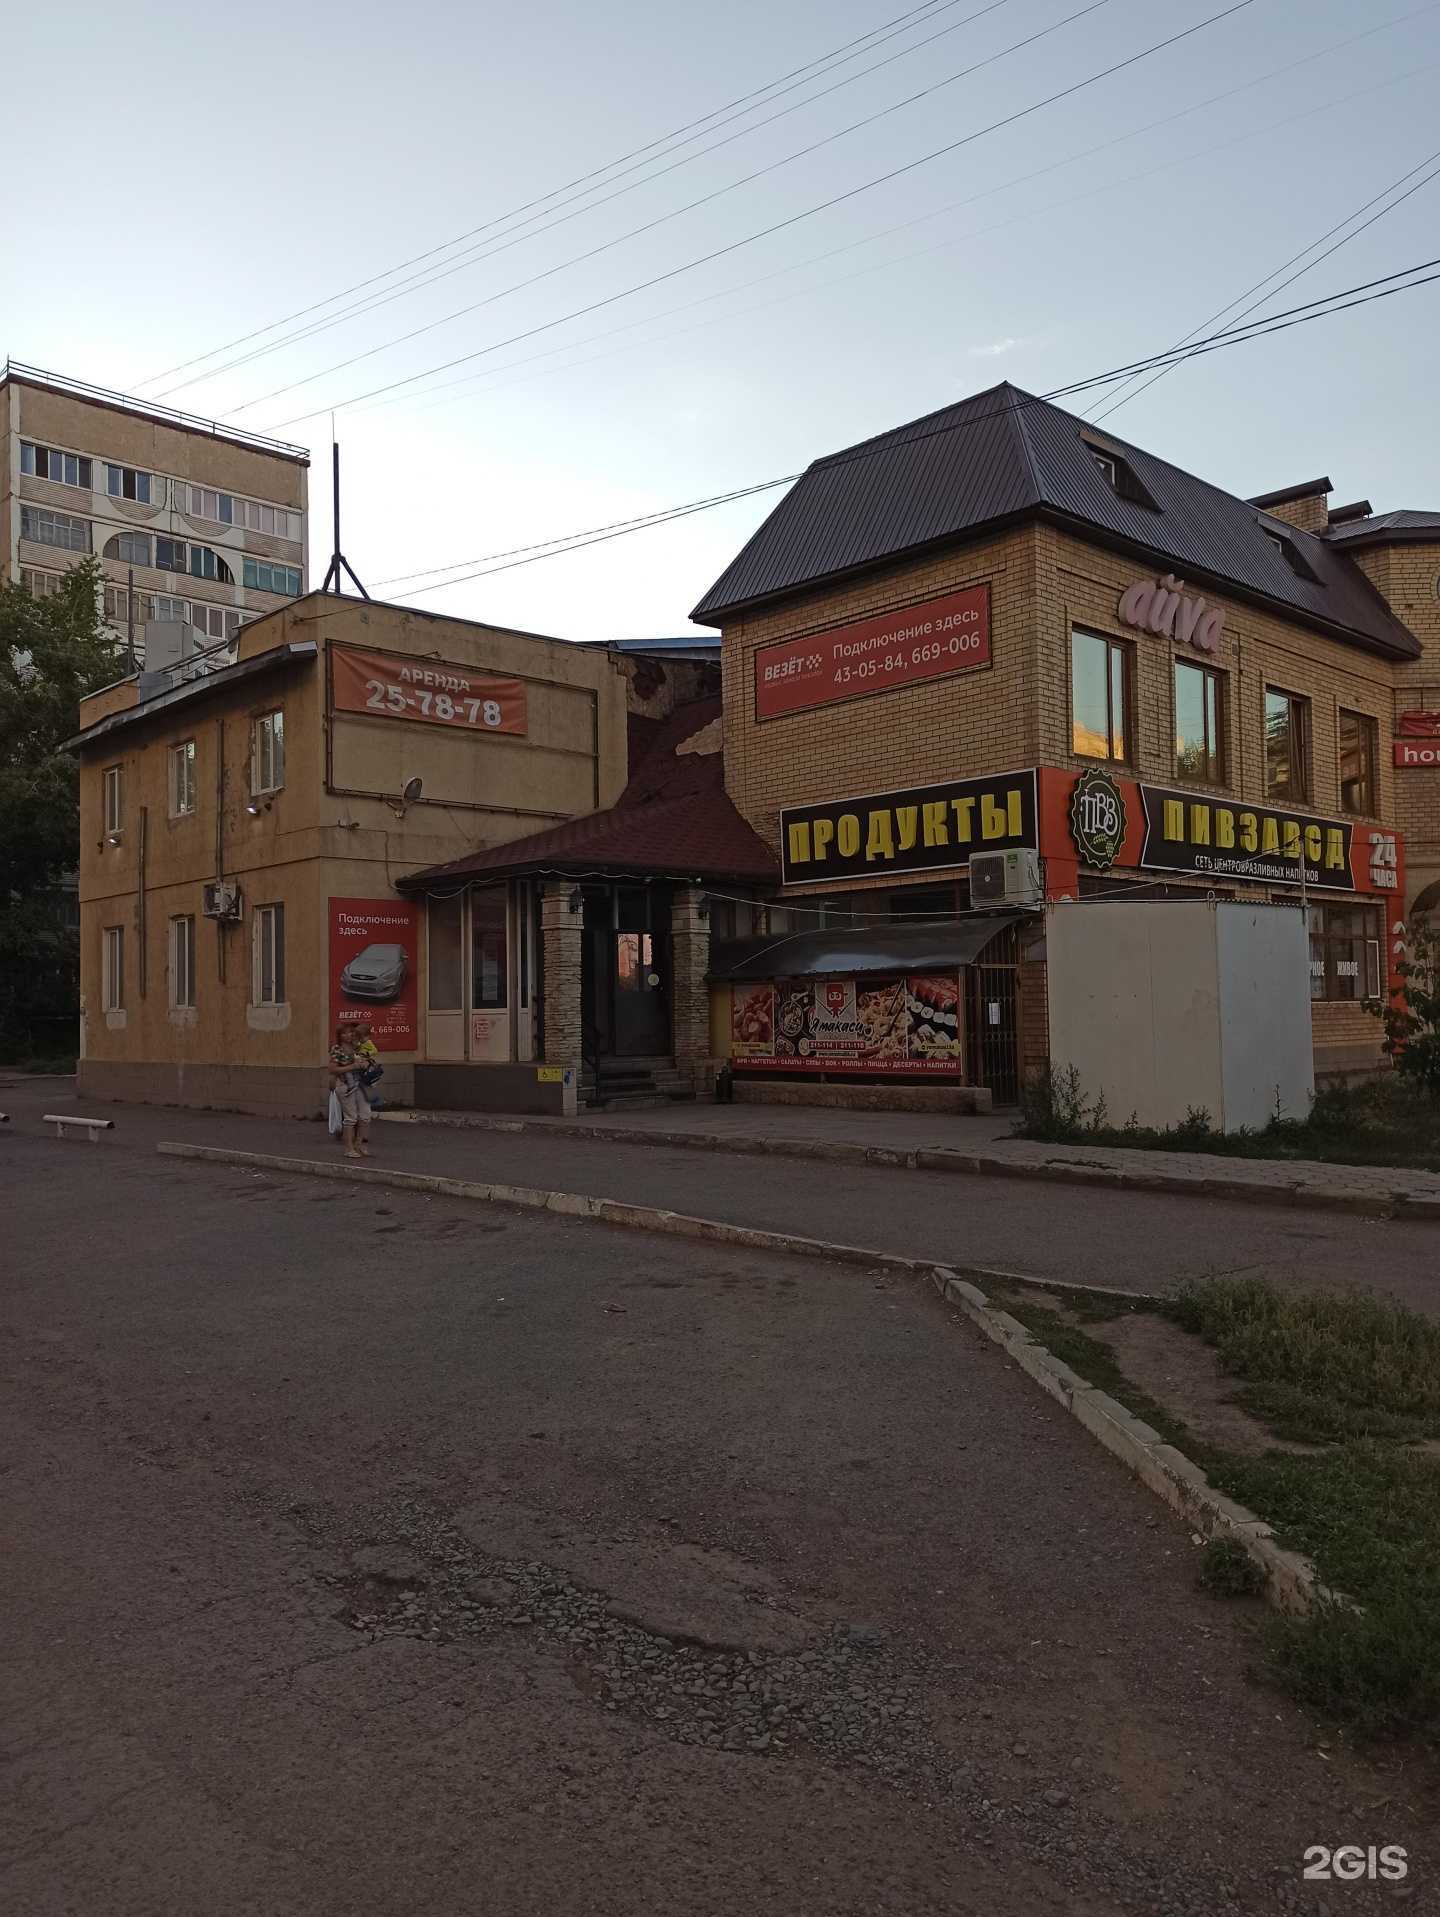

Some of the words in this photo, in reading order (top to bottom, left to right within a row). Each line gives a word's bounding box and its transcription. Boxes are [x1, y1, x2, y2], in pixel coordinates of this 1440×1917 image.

[832, 622, 932, 660] Подключение
[935, 609, 979, 635] здесь
[764, 656, 805, 681] ВЕЗЁТ
[833, 652, 909, 685] 43-05-84,
[911, 631, 981, 665] 669-006
[398, 667, 471, 692] АРЕНДА
[365, 679, 502, 726] 25-78-78
[1404, 746, 1440, 763] ho
[788, 790, 1023, 864] ПРОДУКТЫ
[1163, 799, 1346, 871] ПИВЗАВОД
[1195, 855, 1213, 869] СЕТЬ
[1368, 832, 1397, 868] 24
[338, 913, 409, 925] Подключение
[338, 926, 368, 936] здесь
[892, 1061, 922, 1069] ДЕСЕРТЫ
